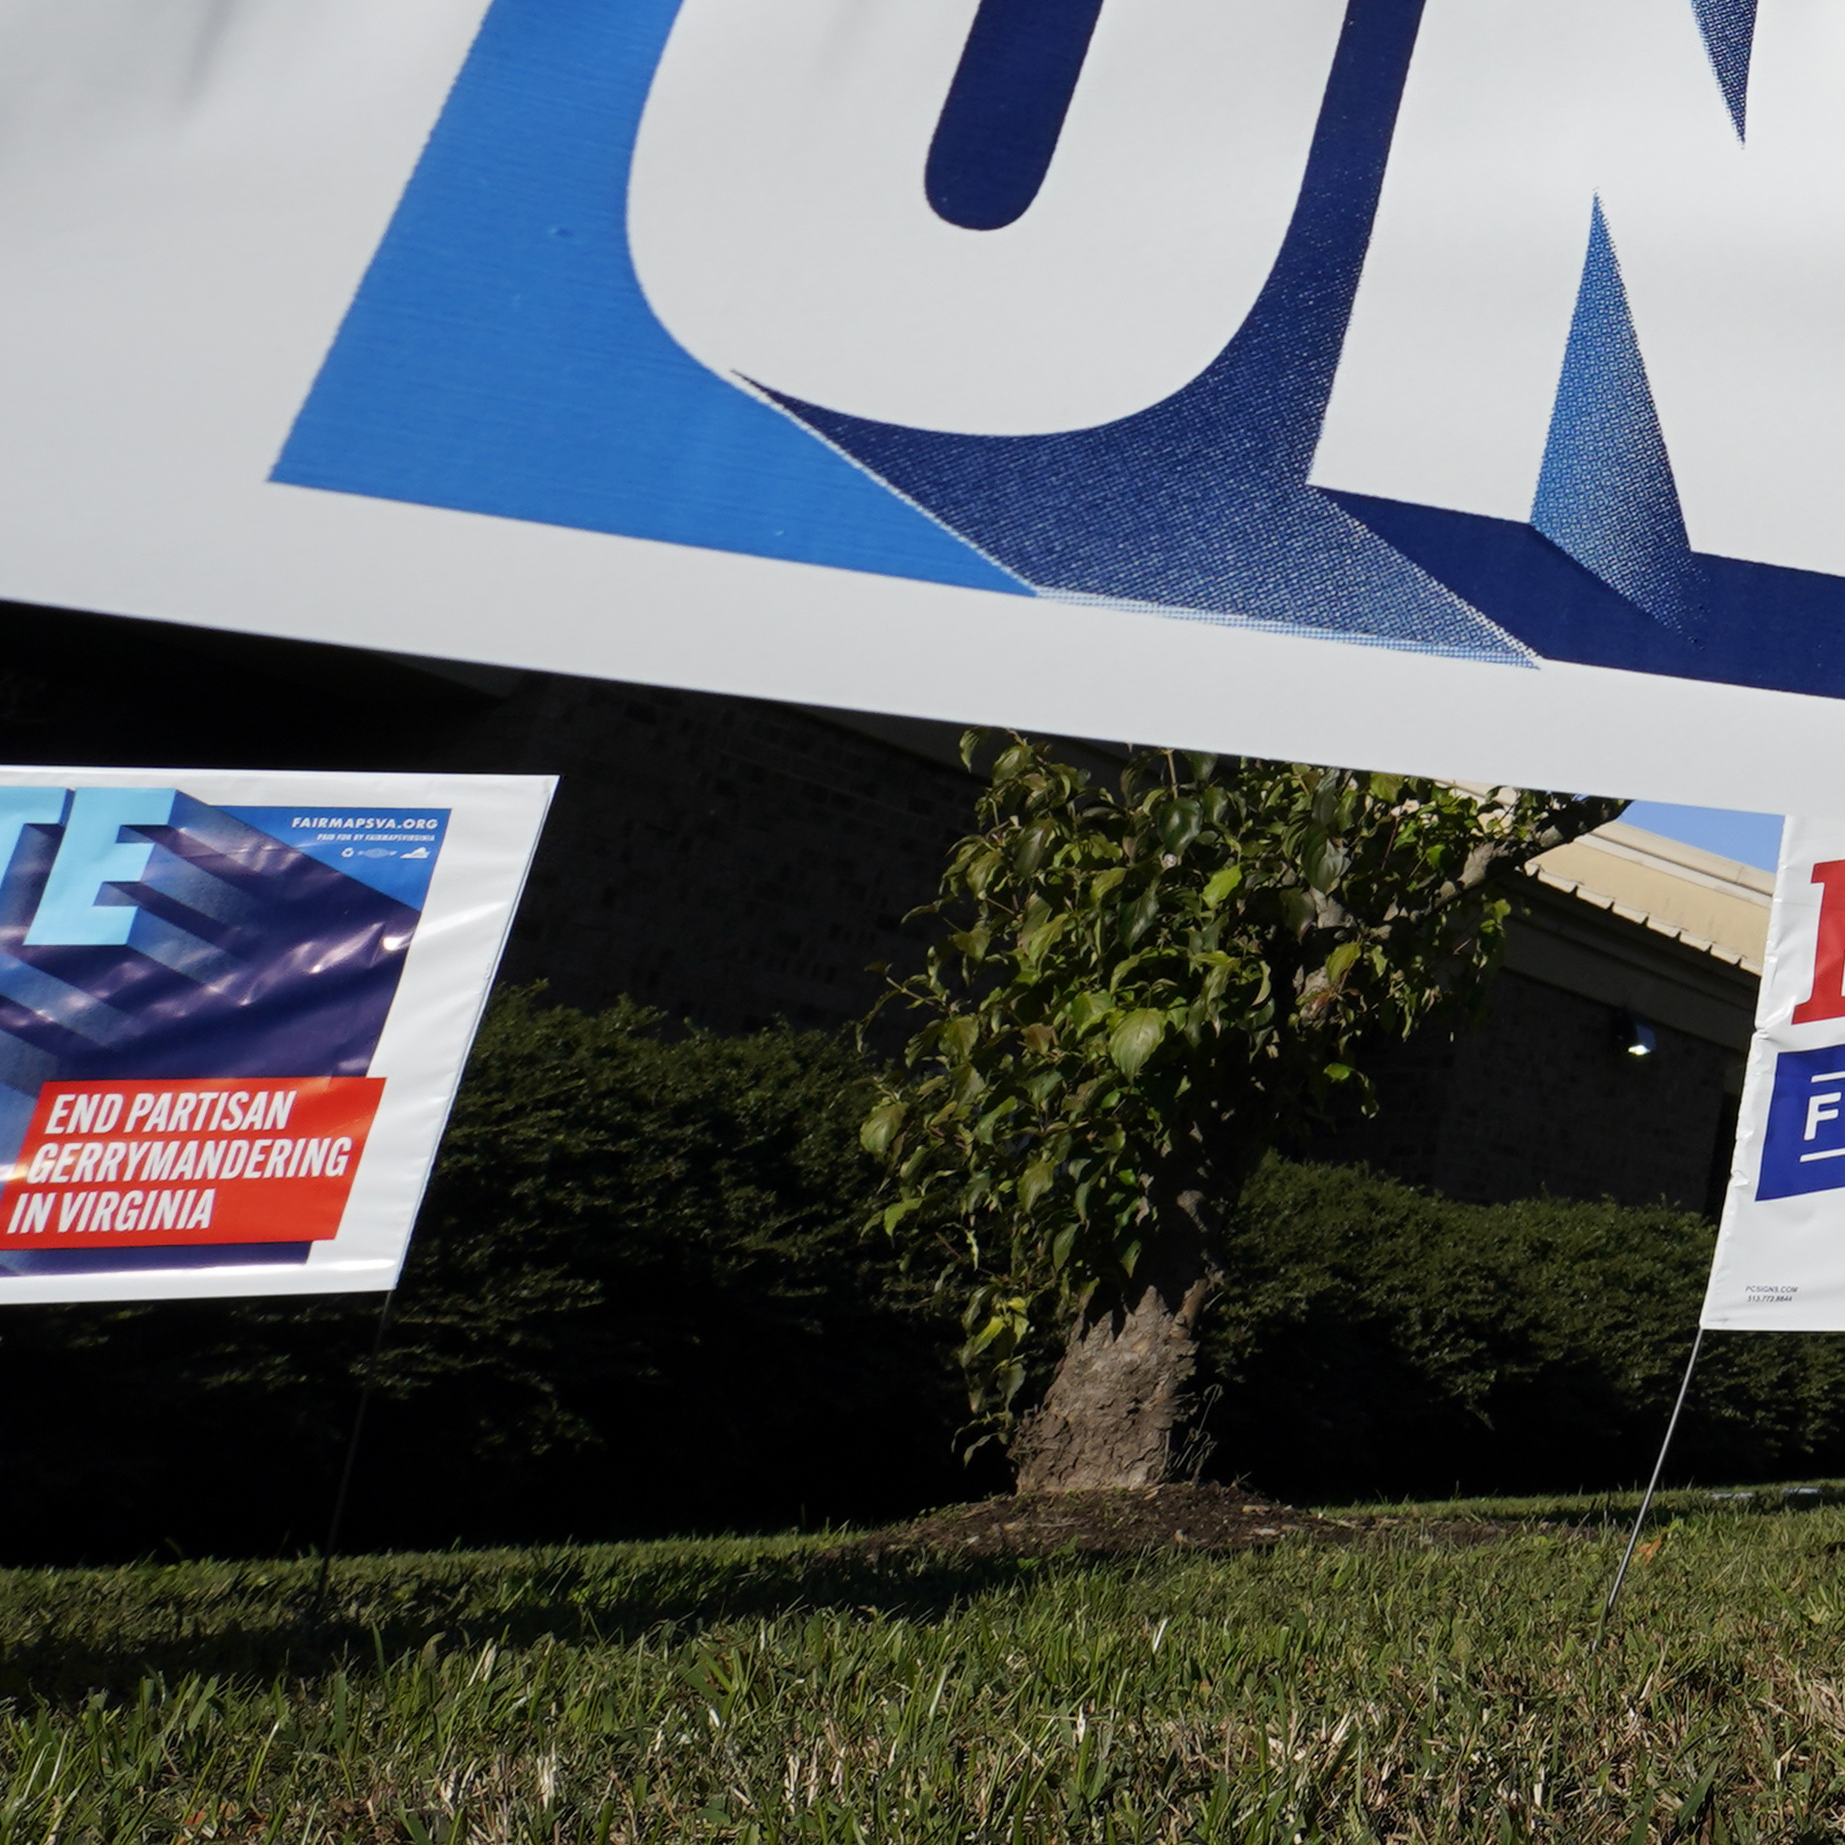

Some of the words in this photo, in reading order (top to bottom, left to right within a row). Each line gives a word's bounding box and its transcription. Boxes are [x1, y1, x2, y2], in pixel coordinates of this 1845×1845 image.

[291, 817, 439, 830] FAIRMAPSVA.ORG
[44, 1092, 122, 1135] END
[124, 1089, 296, 1133] PARTISAN
[26, 1137, 352, 1184] GERRYMANDERING
[7, 1192, 53, 1234] IN
[58, 1188, 215, 1233] VIRGINIA
